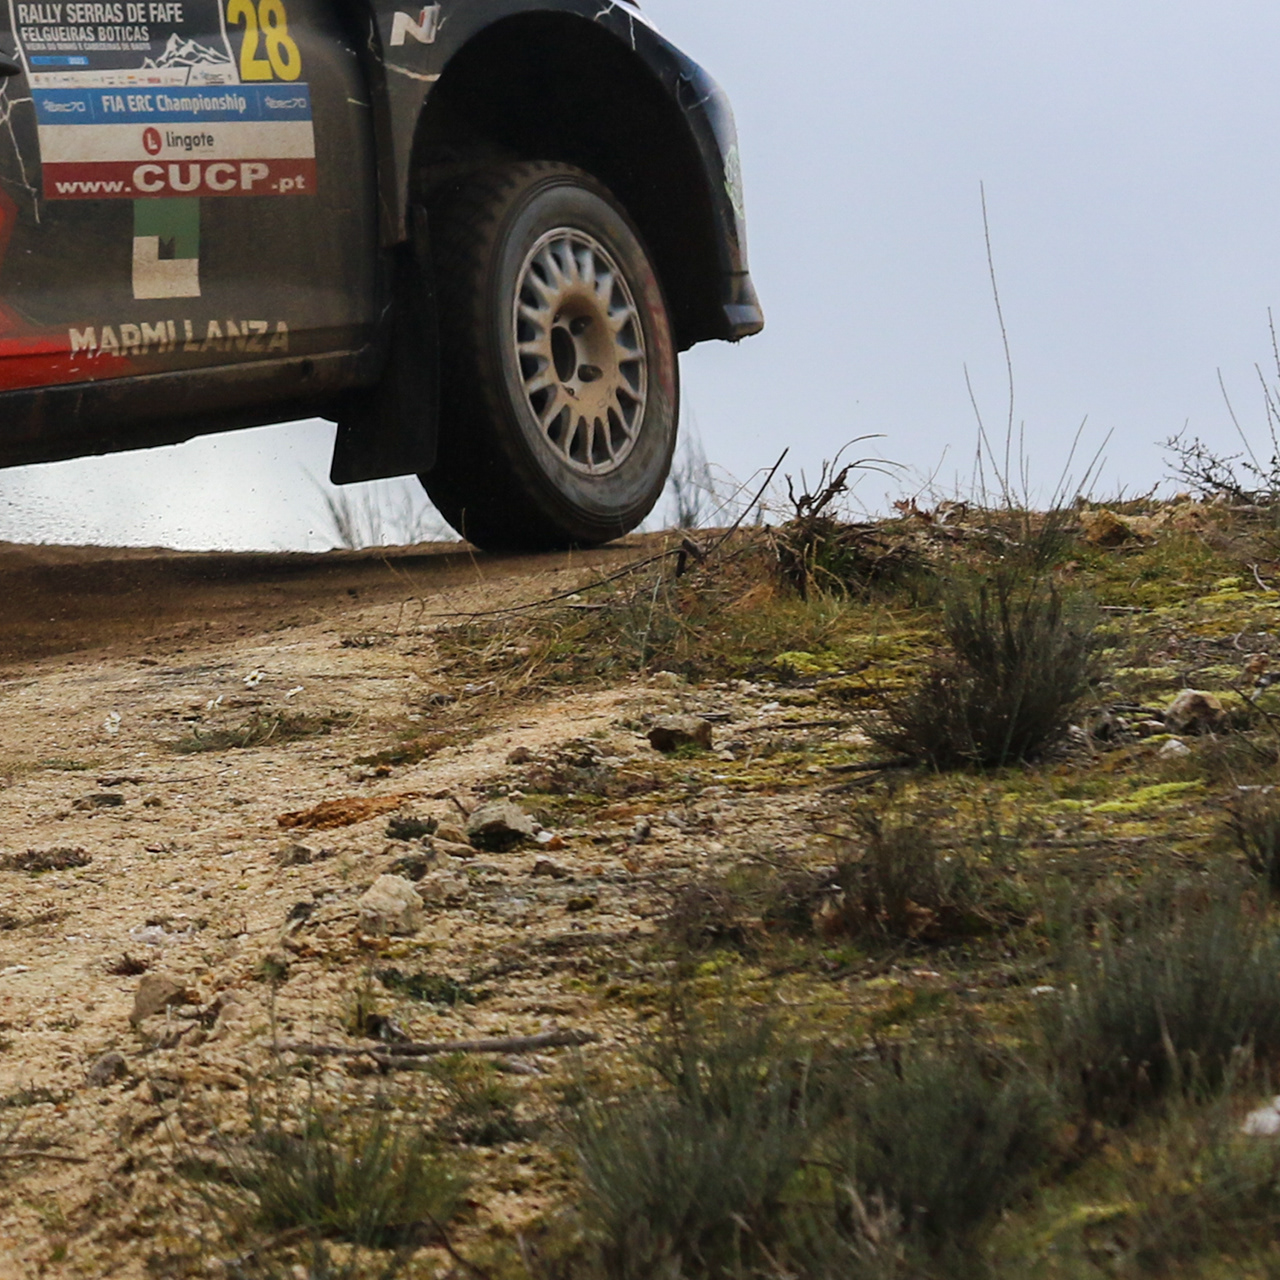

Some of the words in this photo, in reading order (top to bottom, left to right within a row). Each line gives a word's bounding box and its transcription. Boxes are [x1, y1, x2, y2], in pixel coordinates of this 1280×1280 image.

[18, 4, 62, 24] RALLY
[66, 3, 124, 23] SERRAS
[126, 3, 147, 23] DE
[149, 3, 184, 23] FAFE
[21, 26, 95, 42] FELGUEIRAS
[98, 26, 150, 42] BOTICAS
[101, 95, 125, 113] FIA
[129, 95, 154, 112] ERC
[156, 94, 247, 114] Championship
[55, 162, 306, 193] www.CUCP.pt
[69, 321, 178, 360] MARMI
[182, 319, 290, 354] LANZA
